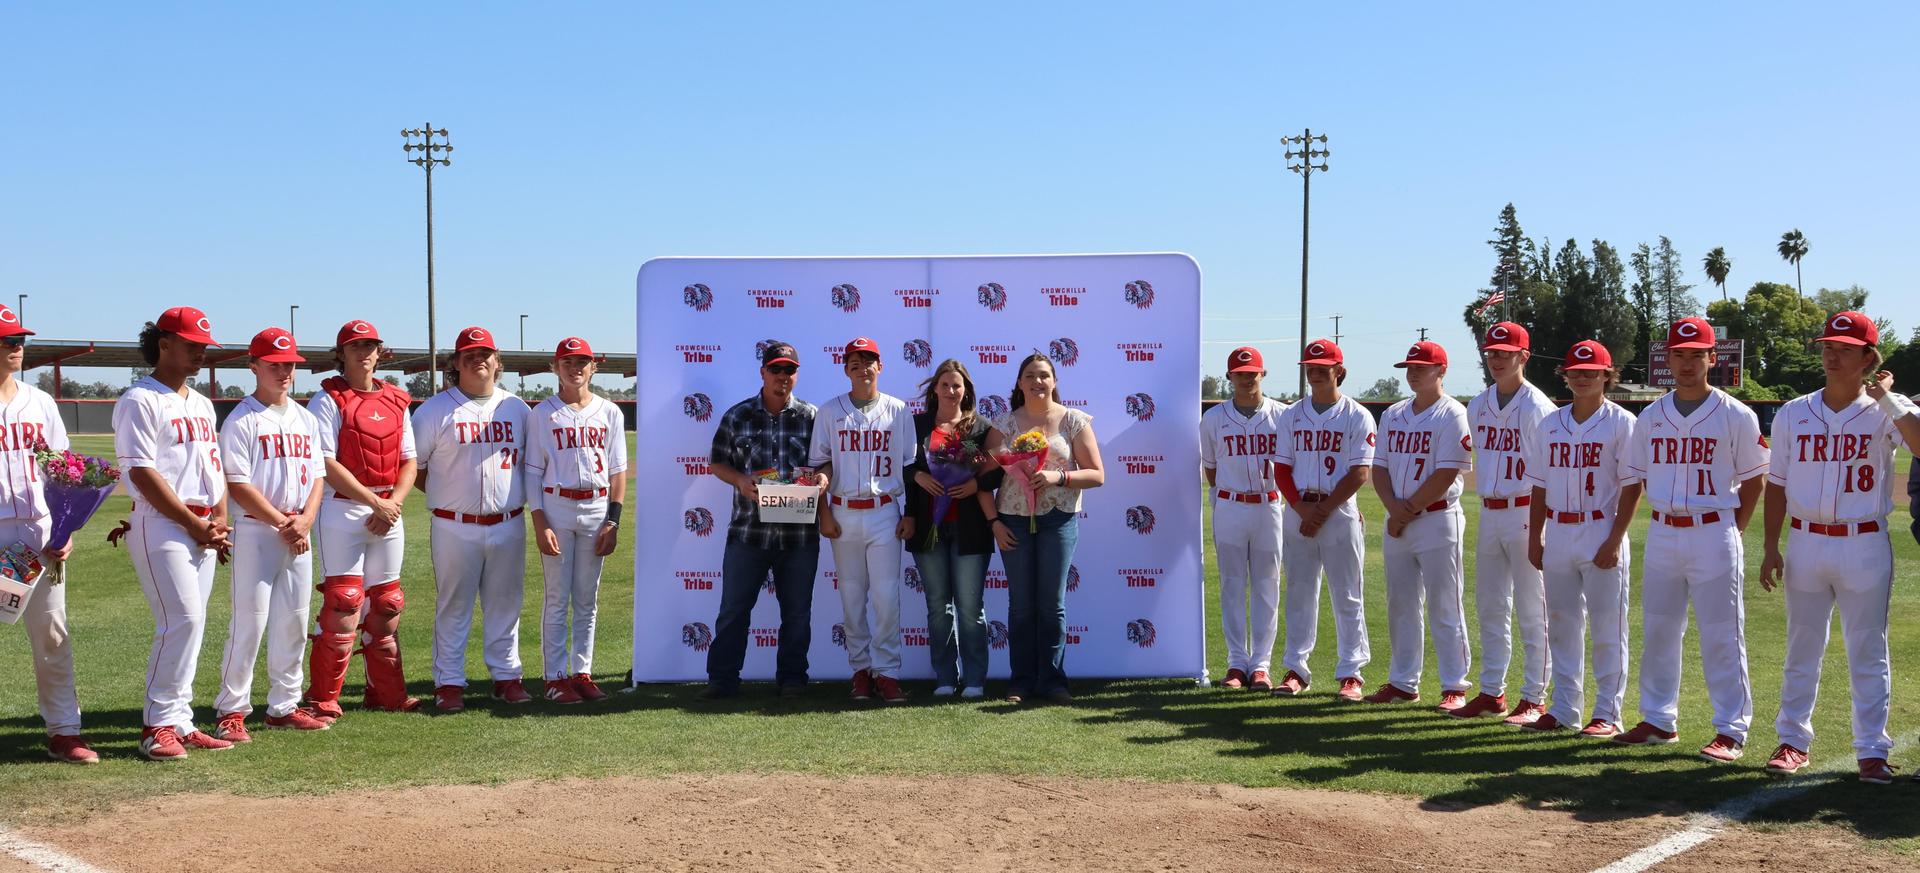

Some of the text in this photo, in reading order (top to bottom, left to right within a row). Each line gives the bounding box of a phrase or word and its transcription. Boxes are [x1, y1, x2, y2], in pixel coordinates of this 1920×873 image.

[894, 288, 940, 296] CHOWCHILLA
[755, 297, 785, 308] Tribe
[902, 296, 932, 308] Tribe
[1049, 294, 1078, 306] Tribe
[352, 322, 370, 334] C
[1677, 322, 1698, 337] C
[1831, 315, 1853, 331] C
[468, 329, 485, 341] C
[1491, 326, 1509, 340] C
[272, 335, 291, 350] C
[565, 339, 582, 350] C
[852, 337, 868, 348] C
[1309, 343, 1325, 356] C
[683, 351, 713, 363] Tribe
[978, 352, 1008, 364] Tribe
[1125, 350, 1154, 361] Tribe
[1237, 350, 1252, 362] C
[1573, 345, 1593, 359] C
[455, 421, 514, 444] TRIBE
[552, 426, 607, 450] TRIBE
[258, 433, 312, 460] TRIBE
[838, 430, 892, 452] TRIBE
[1223, 434, 1277, 456] TRIBE
[1293, 430, 1344, 453] TRIBE
[1387, 430, 1433, 454] TRIBE
[1796, 433, 1872, 462] TRIBE
[1549, 441, 1603, 468] TRIBE
[1651, 437, 1717, 464] TRIBE
[593, 452, 604, 474] 3
[874, 456, 892, 478] 13
[1126, 462, 1155, 474] Tribe
[1324, 456, 1336, 476] 9
[1413, 458, 1426, 481] 7
[300, 463, 307, 486] 8
[1844, 464, 1874, 493] 18
[1585, 471, 1595, 496] 4
[1696, 469, 1717, 496] 11
[683, 578, 713, 590] Tribe
[984, 577, 1008, 588] ribe
[1126, 576, 1155, 587] Tribe
[755, 635, 777, 647] Trib
